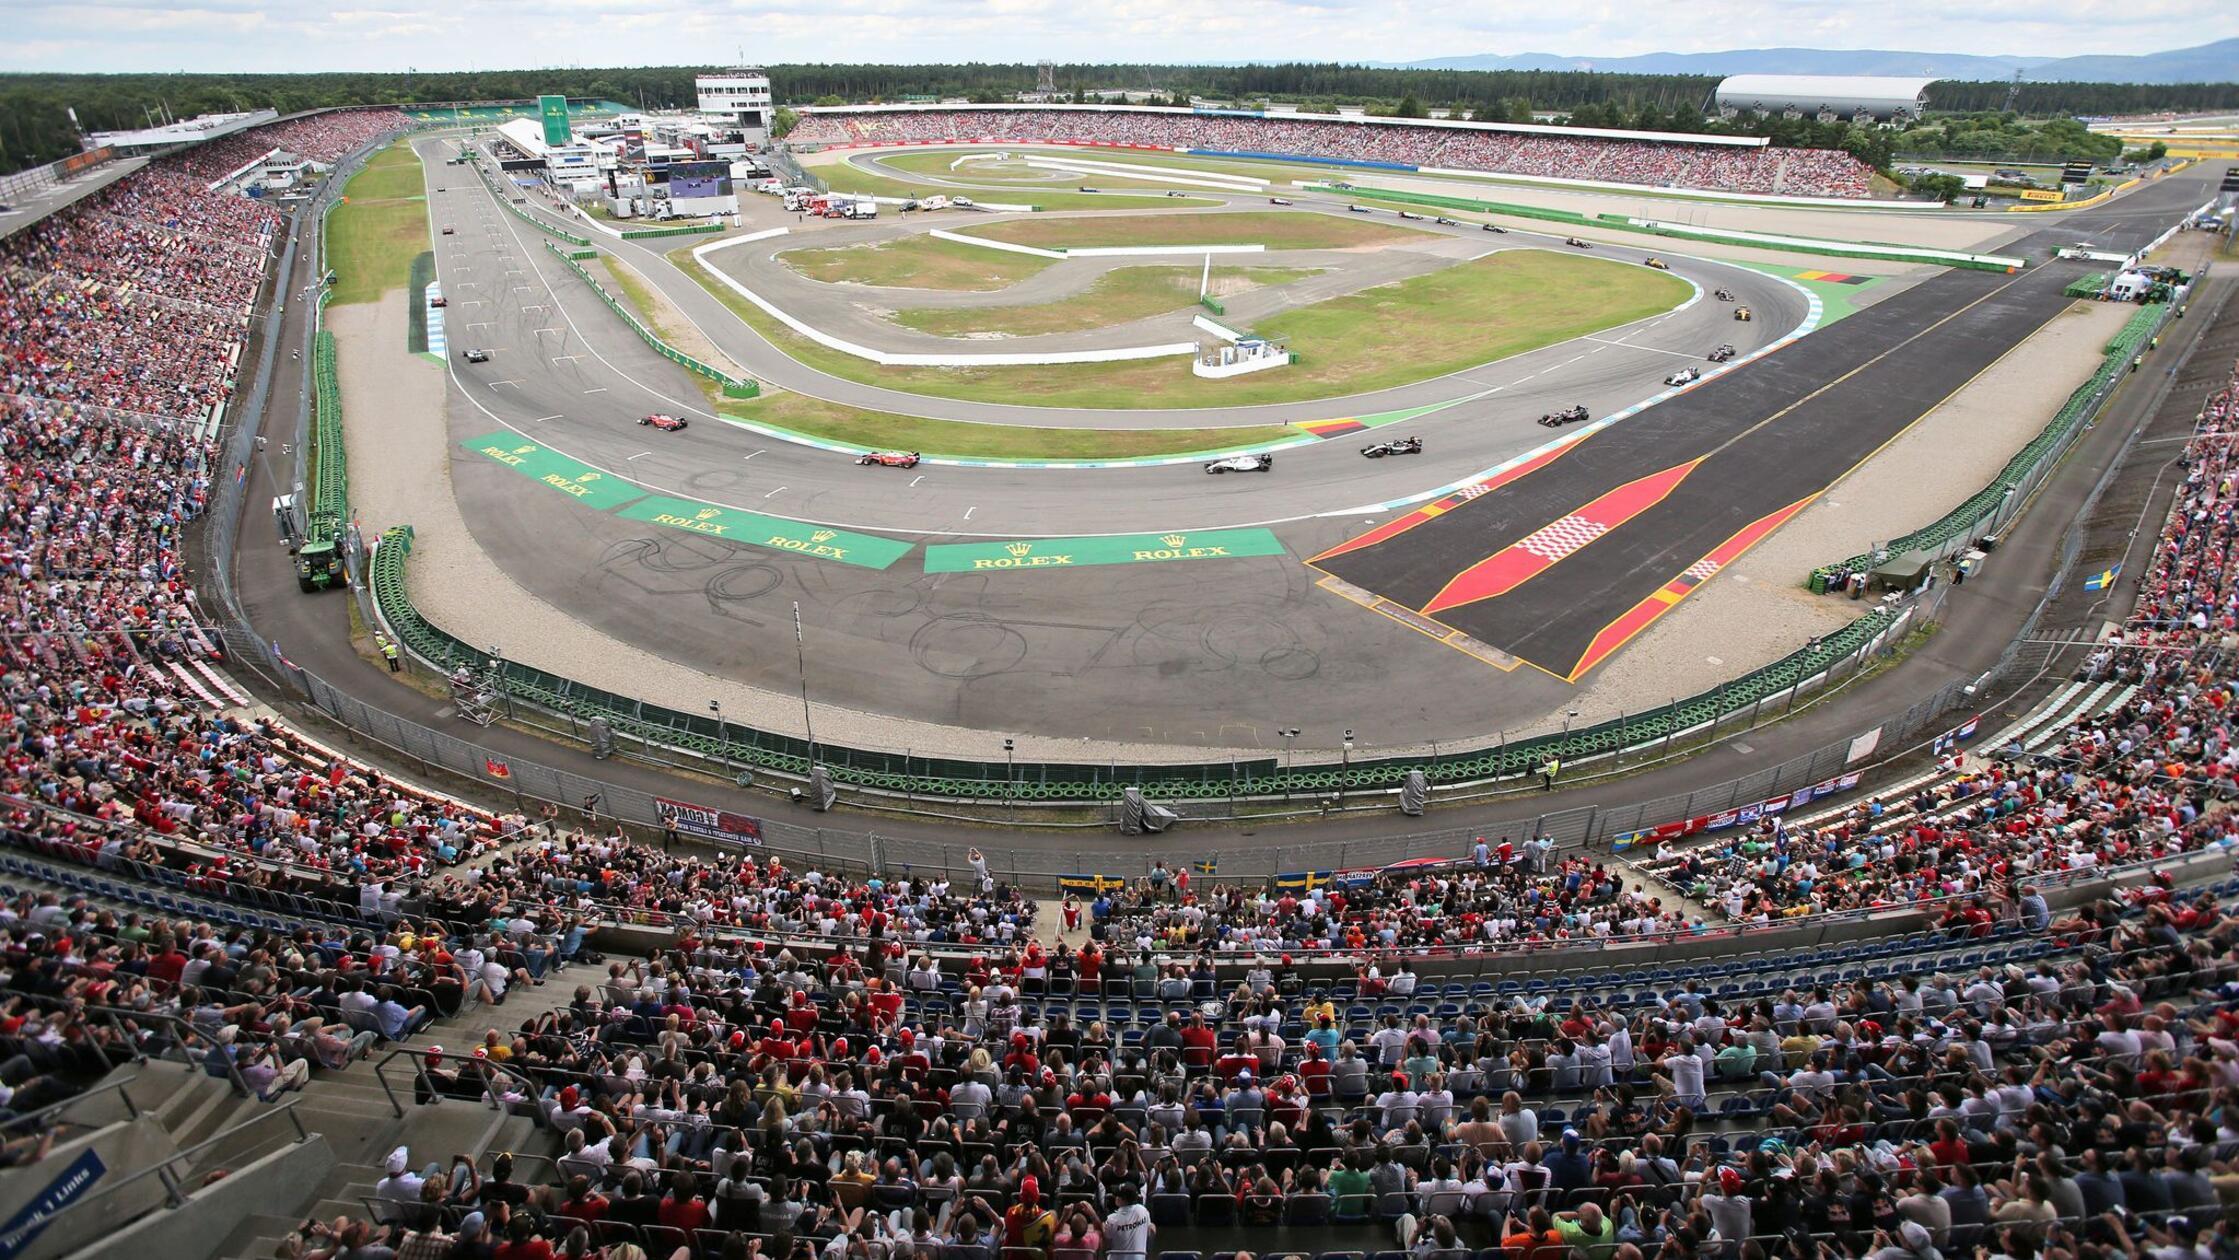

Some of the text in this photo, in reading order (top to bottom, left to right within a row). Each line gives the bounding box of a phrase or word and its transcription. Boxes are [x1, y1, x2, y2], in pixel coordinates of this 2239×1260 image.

[480, 446, 527, 466] ROLEX
[540, 473, 594, 497] ROLEX
[653, 514, 730, 535] ROLEX
[765, 536, 850, 559] ROLEX
[1132, 546, 1231, 560] ROLEX
[974, 555, 1073, 568] ROLEX
[55, 1168, 90, 1202] Links
